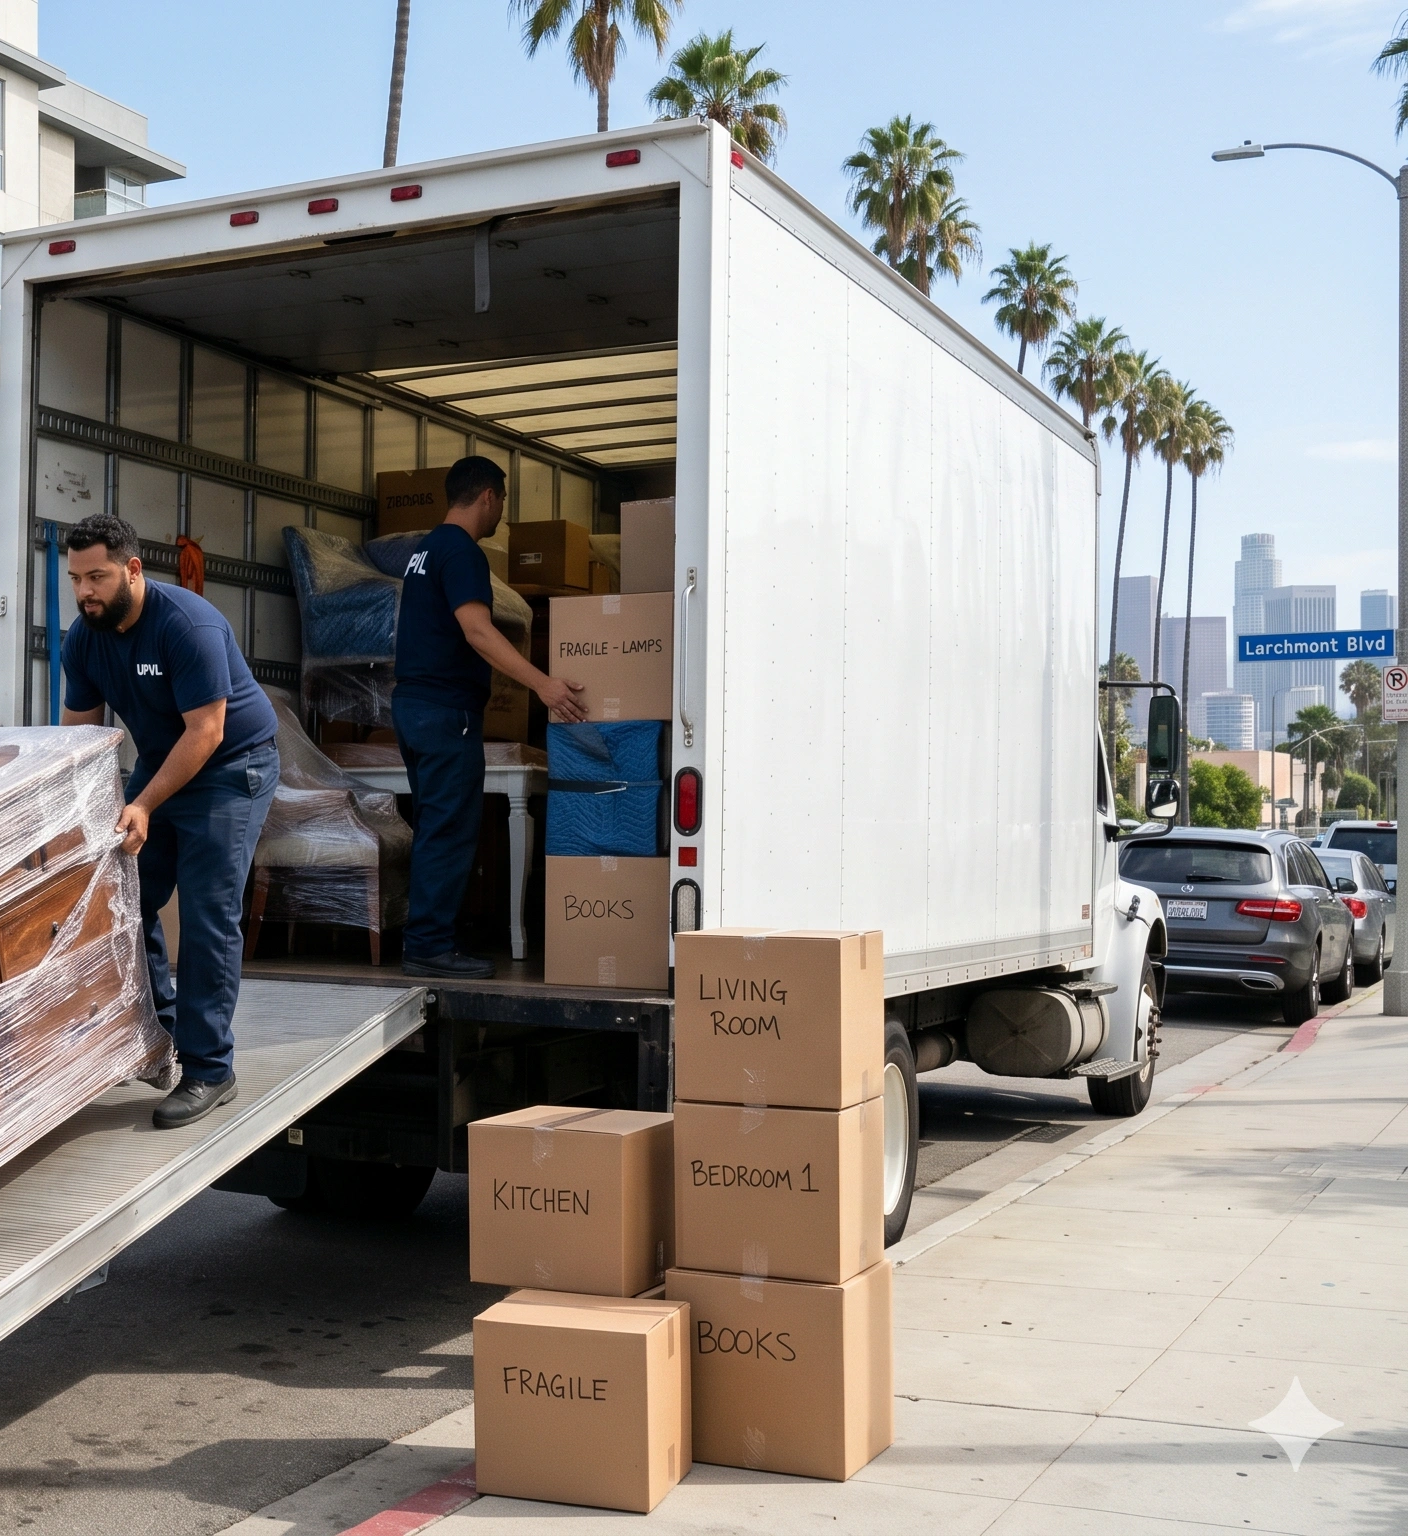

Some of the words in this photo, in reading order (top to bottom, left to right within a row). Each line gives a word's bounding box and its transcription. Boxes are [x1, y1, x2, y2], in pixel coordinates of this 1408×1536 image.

[559, 641, 609, 658] FRAGILE
[622, 638, 663, 654] LAMPS
[1245, 638, 1339, 656] Larchmont
[1347, 635, 1386, 652] Blvd
[136, 663, 163, 676] UPVL
[564, 894, 635, 921] BOOKS
[699, 973, 788, 1006] LIVING
[710, 1010, 781, 1041] ROOM
[690, 1159, 793, 1191] BEDROOM
[800, 1162, 820, 1193] 1
[493, 1178, 590, 1216] KITCHEN
[697, 1320, 796, 1362] BOOKS
[503, 1366, 609, 1401] FRAGILE
